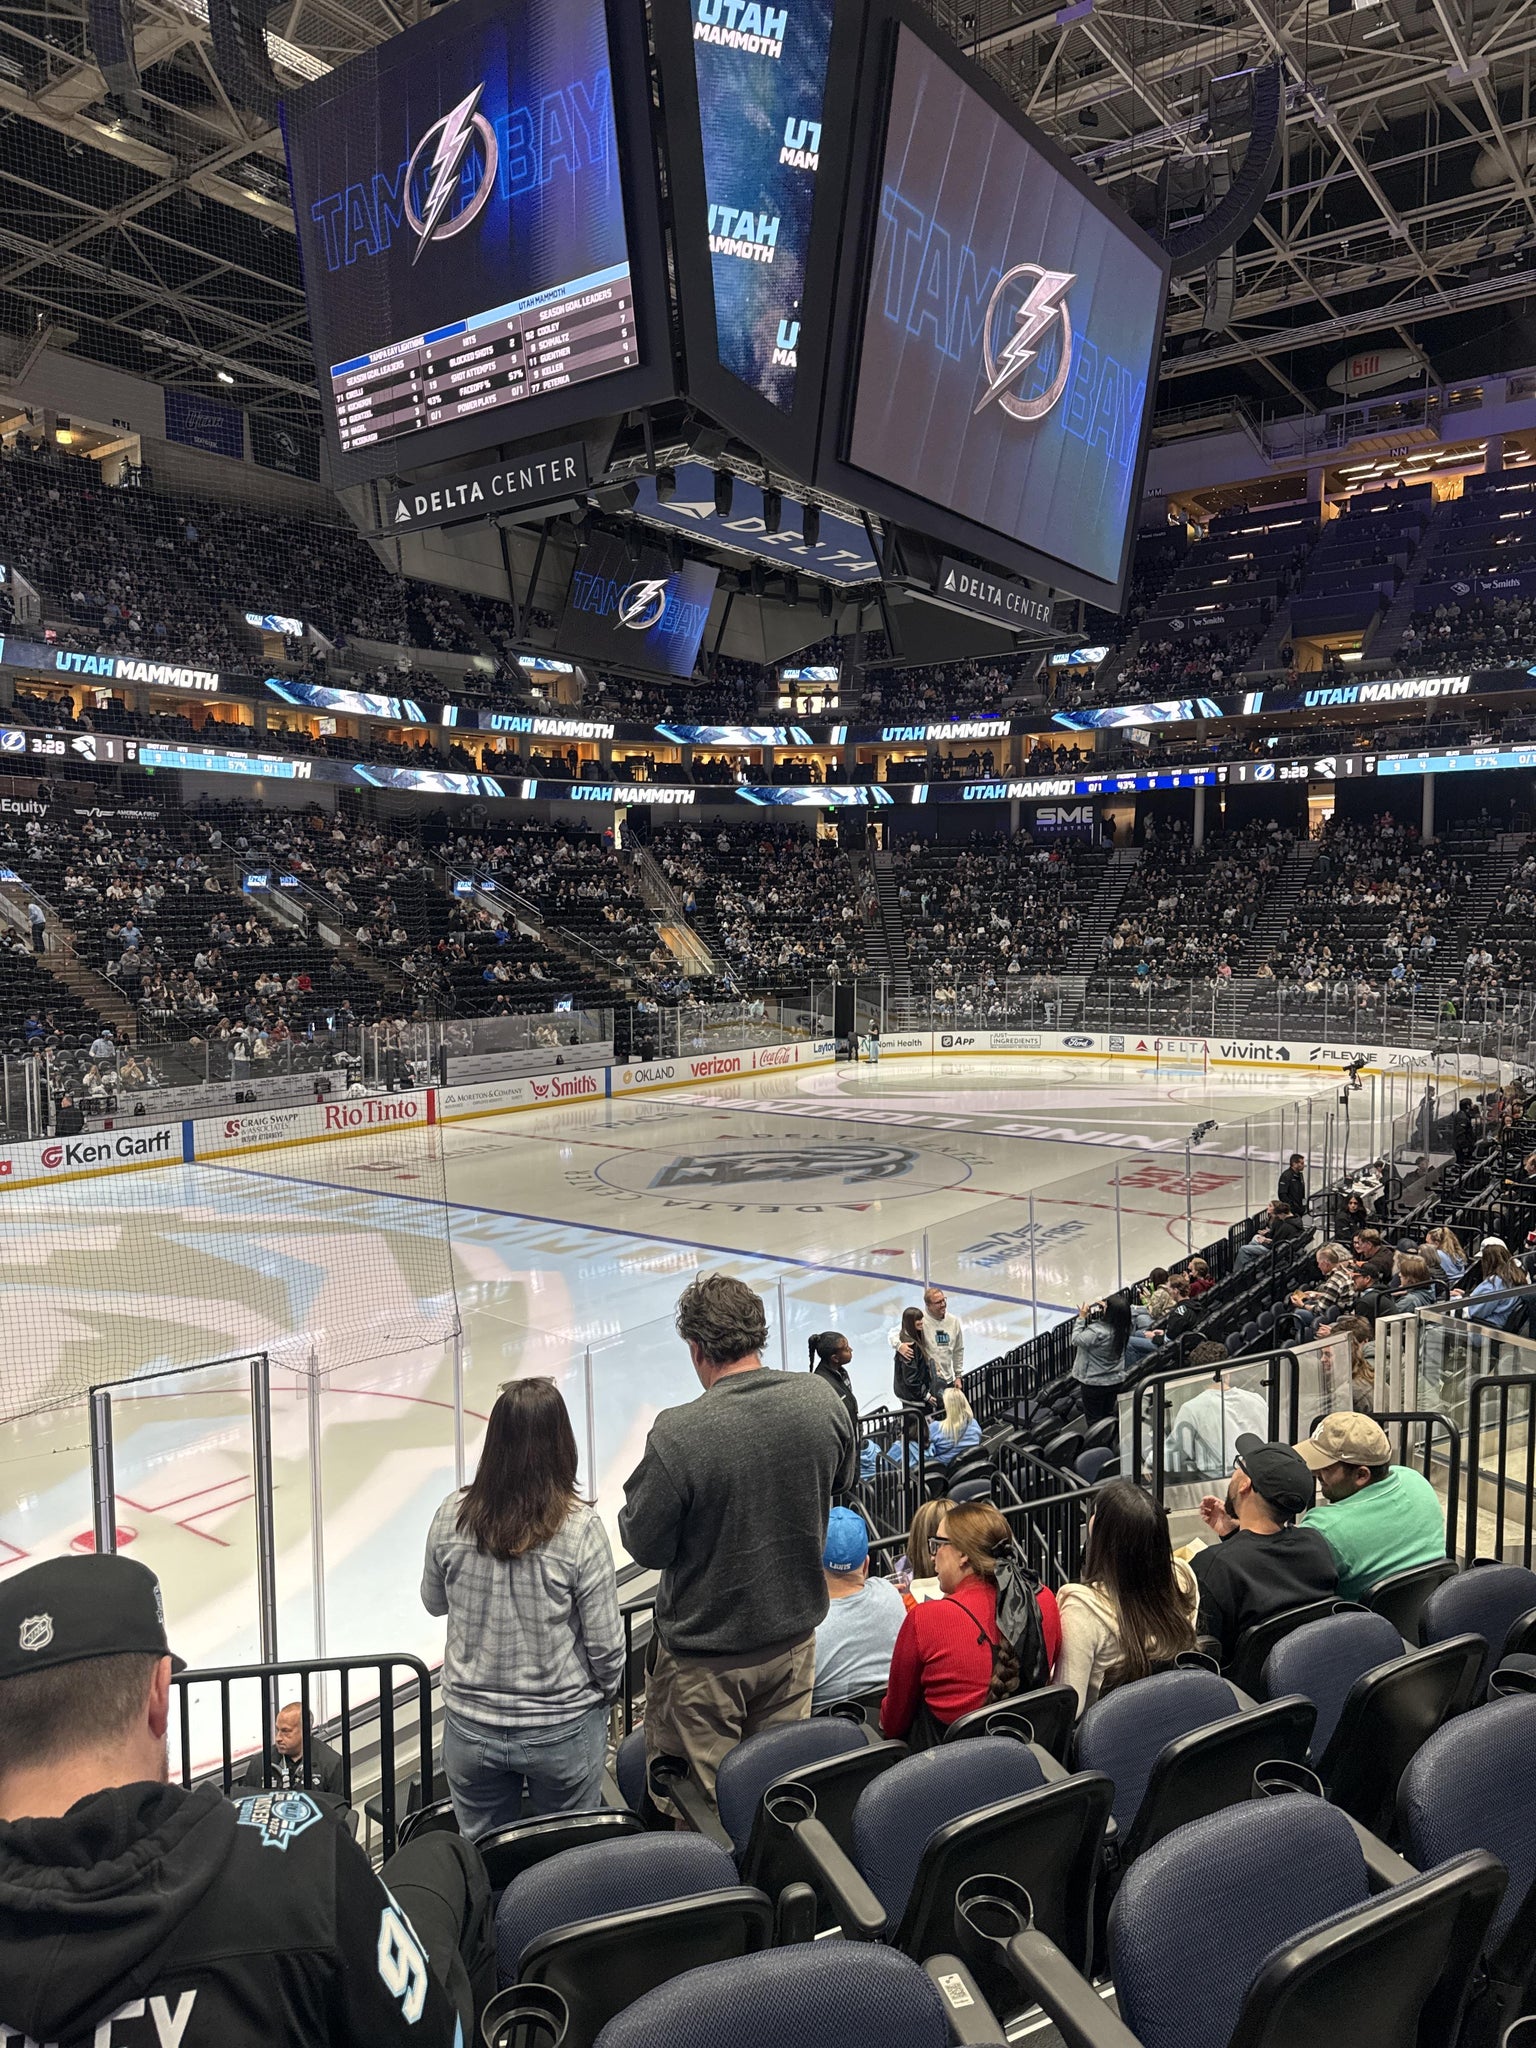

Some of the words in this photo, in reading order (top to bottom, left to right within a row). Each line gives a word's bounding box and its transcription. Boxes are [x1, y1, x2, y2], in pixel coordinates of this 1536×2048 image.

[697, 0, 788, 41] UTAH
[694, 22, 783, 59] MAMMOTH
[779, 147, 819, 171] MAM
[518, 299, 534, 310] UTAH
[535, 287, 566, 304] MAMMOTH
[539, 305, 565, 321] SEASON
[565, 300, 582, 313] GOAL
[582, 288, 612, 306] LEADERS
[462, 334, 477, 347] HITS
[525, 331, 535, 340] 92
[537, 322, 560, 336] COOLEY
[538, 332, 570, 350] SCHMALTZ
[776, 319, 799, 350] U
[449, 351, 474, 368] BLOCKED
[474, 345, 494, 359] SHOTS
[529, 357, 537, 366] 11
[450, 371, 466, 383] SHOT
[466, 361, 496, 379] ATTEMPTS
[542, 362, 564, 376] KELLER
[1352, 356, 1380, 378] bill
[459, 381, 484, 396] FACEOFF
[508, 369, 523, 381] 57%
[531, 384, 540, 393] 77
[543, 375, 570, 390] PETERKA
[457, 400, 477, 413] POWER
[477, 394, 497, 407] PLAYS
[414, 481, 484, 515] DELTA
[492, 457, 577, 496] CENTER
[958, 578, 1002, 607] DELTA
[1006, 592, 1051, 623] CENTER
[56, 651, 114, 676] UTAH
[116, 660, 219, 691] MAMMOTH
[1304, 687, 1358, 707] UTAH
[1359, 676, 1470, 702] MAMMOTH
[490, 714, 532, 733] UTAH
[532, 718, 615, 739] MAMMOTH
[882, 726, 925, 742] UTAH
[926, 720, 1011, 740] MAMMOTH
[32, 739, 65, 755] 3:28
[106, 741, 114, 758] 1
[1279, 765, 1308, 779] 3:28
[1345, 758, 1353, 774] 1
[1449, 759, 1456, 768] 2
[1475, 757, 1498, 767] 57%
[1088, 782, 1102, 792] 0/1
[1117, 780, 1136, 790] 43%
[1149, 779, 1155, 788] 6
[1173, 777, 1180, 786] 6
[1194, 775, 1205, 785] 19
[1239, 766, 1246, 781] 1
[570, 785, 613, 801] UTAH
[613, 786, 695, 804] MAMMOTH
[963, 784, 1006, 800] UTAH
[0, 799, 48, 817] Equity
[1036, 806, 1093, 825] SME
[813, 1040, 836, 1055] Layton
[897, 1038, 922, 1048] Health
[1068, 1036, 1089, 1047] Ford
[1154, 1041, 1210, 1053] DELTA
[1220, 1042, 1274, 1060] vivint
[1323, 1050, 1378, 1062] FILEVINE
[635, 1066, 675, 1083] OKLAND
[690, 1056, 740, 1077] verizon
[551, 1075, 597, 1098] Smith's
[241, 1117, 268, 1128] CRAIG
[270, 1113, 298, 1124] SWAPP
[65, 1142, 111, 1166] Ken
[116, 1129, 170, 1156] Garff
